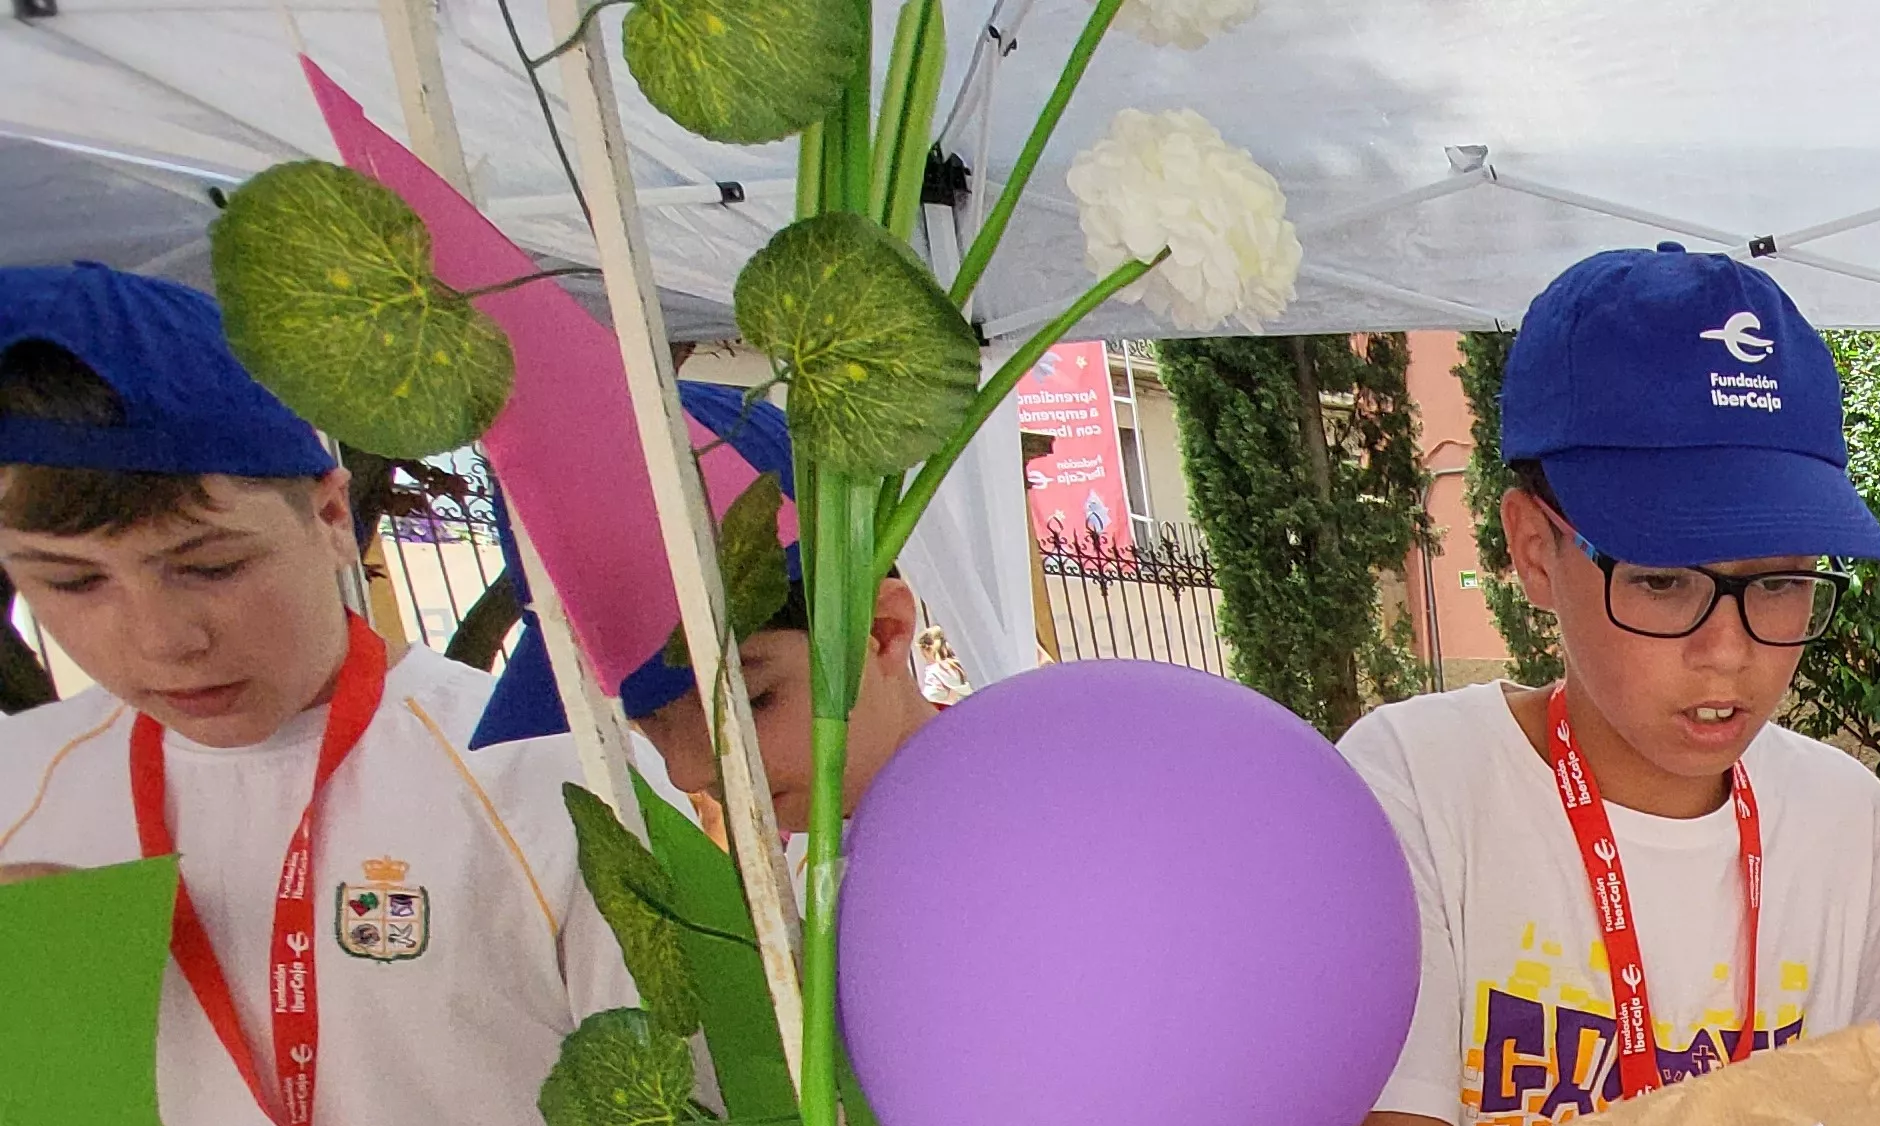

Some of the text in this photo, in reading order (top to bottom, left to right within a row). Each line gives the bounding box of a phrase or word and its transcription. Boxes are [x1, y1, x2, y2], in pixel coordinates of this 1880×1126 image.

[1710, 372, 1778, 390] Fundación
[1557, 759, 1577, 809] Fundación
[1596, 877, 1614, 933] Fundación
[1619, 1002, 1633, 1055] Fundación
